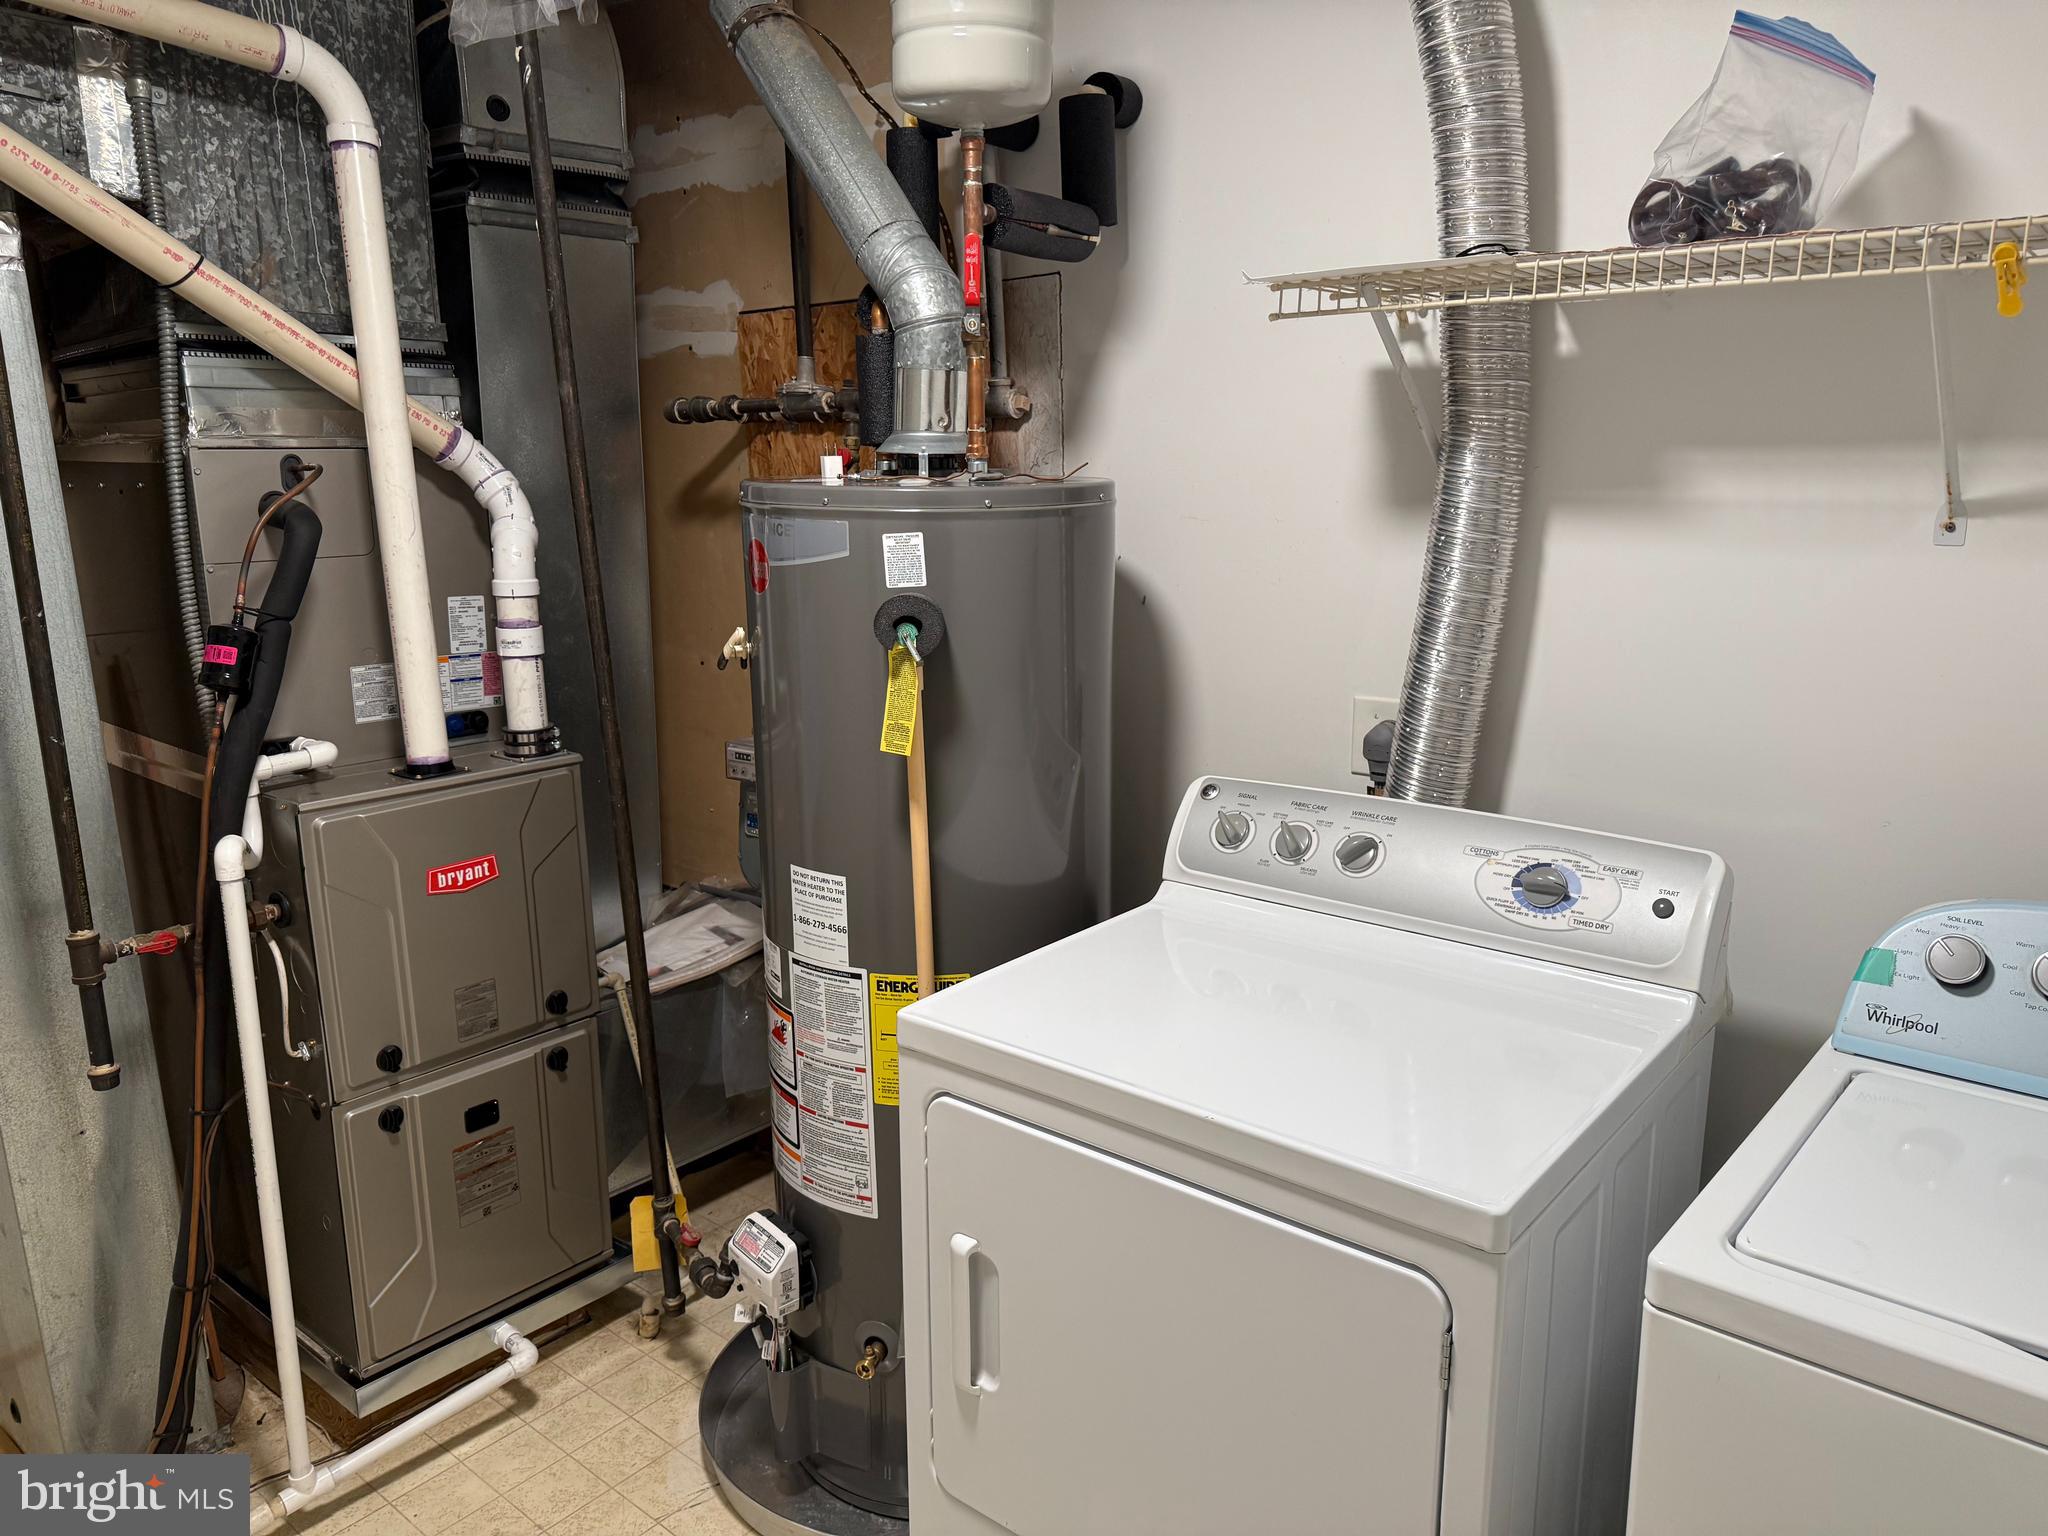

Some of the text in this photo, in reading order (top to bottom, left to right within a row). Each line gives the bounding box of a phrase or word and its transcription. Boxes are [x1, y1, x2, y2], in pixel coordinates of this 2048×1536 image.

[1290, 800, 1312, 809] FABRIC
[1312, 804, 1329, 812] CARE
[1352, 810, 1380, 820] WRINKLE
[1470, 846, 1500, 856] COTTONS
[436, 861, 490, 888] bryant
[1602, 866, 1640, 877] EASY CARE
[800, 872, 810, 880] NOT
[810, 874, 830, 884] RETURN
[792, 878, 806, 888] WATER
[806, 883, 826, 892] HEATER
[794, 887, 808, 896] PLACE
[815, 894, 842, 904] PURCHASE
[1658, 888, 1680, 898] START
[793, 913, 848, 934] 1-866-279-4566
[1572, 918, 1610, 931] TIMED DRY
[1947, 916, 1984, 926] SOIL LEVEL
[1940, 922, 1960, 931] Heavy
[2016, 940, 2036, 949] Warm
[1897, 948, 1914, 957] Light
[1903, 972, 1920, 981] Light
[2010, 990, 2026, 998] Cold
[2024, 1002, 2038, 1010] Tap
[1866, 1008, 1939, 1035] Whirlpool
